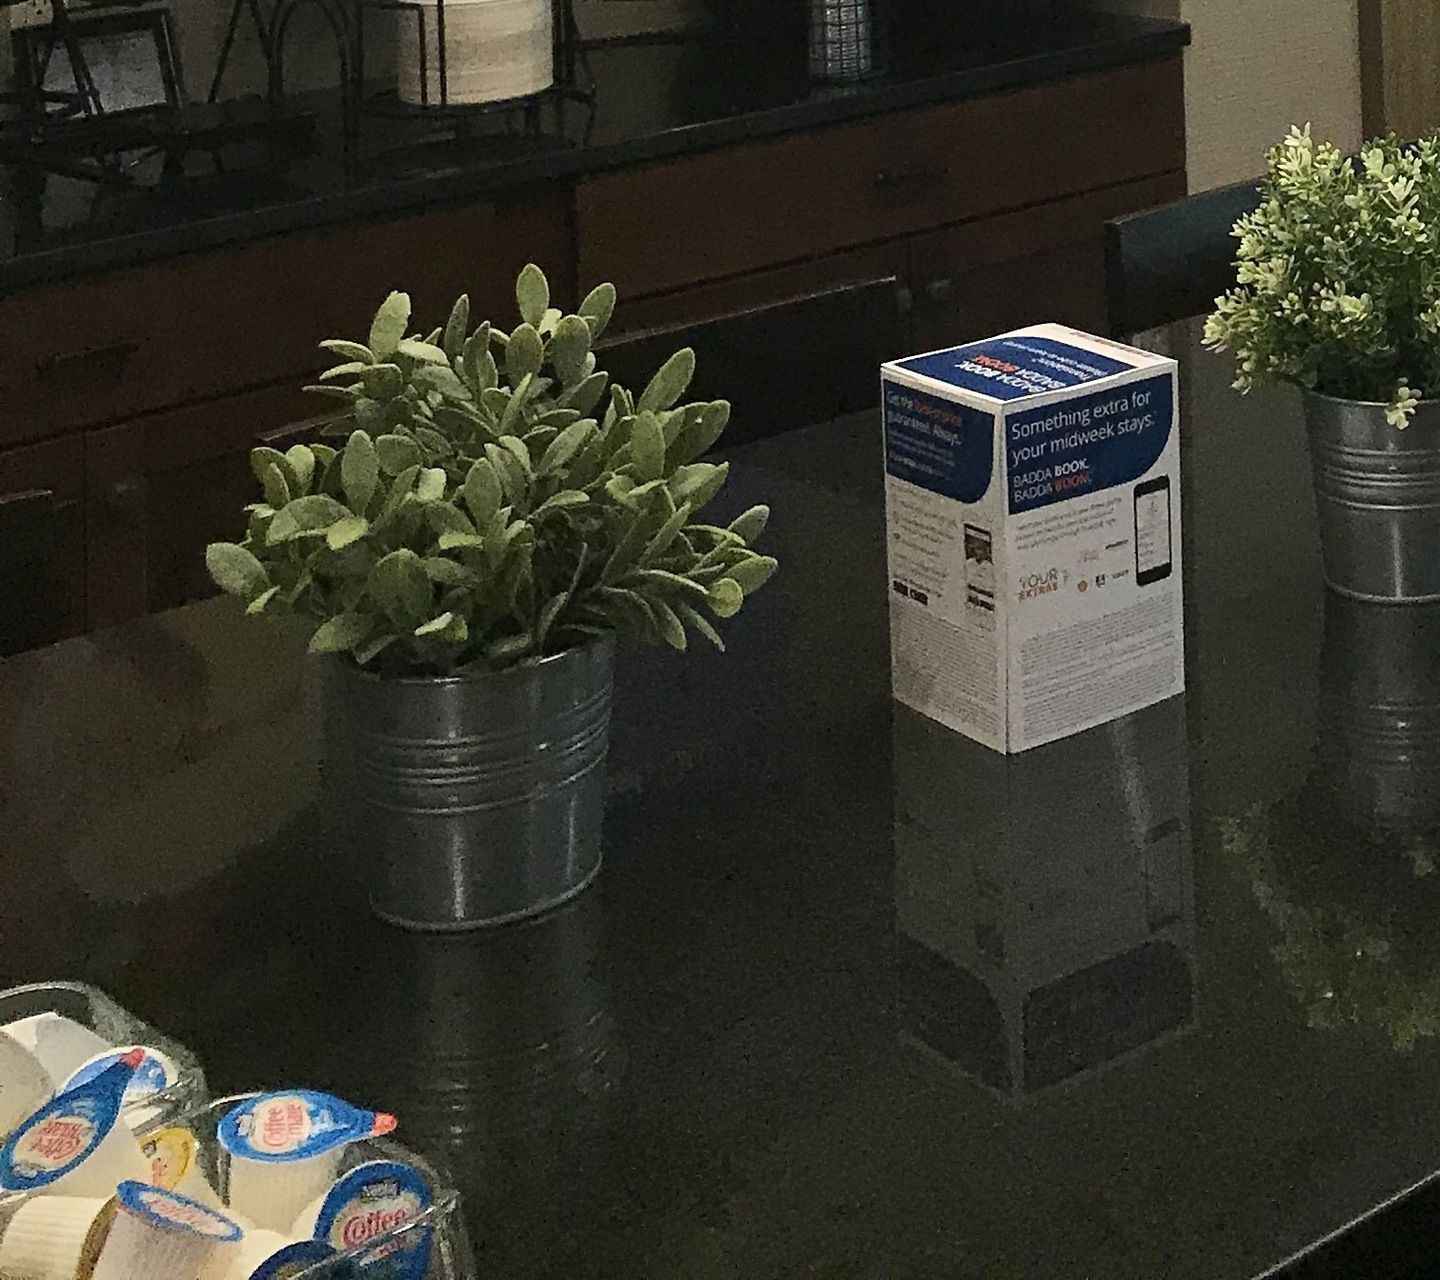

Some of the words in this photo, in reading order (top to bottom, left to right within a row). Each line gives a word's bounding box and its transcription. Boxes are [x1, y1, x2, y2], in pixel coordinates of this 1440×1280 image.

[1011, 406, 1091, 440] Something
[1093, 399, 1129, 418] extra
[1132, 391, 1152, 409] for
[1012, 441, 1048, 467] your
[1050, 421, 1116, 452] midweek
[1013, 467, 1051, 489] BADDA
[1019, 567, 1058, 590] YOUR
